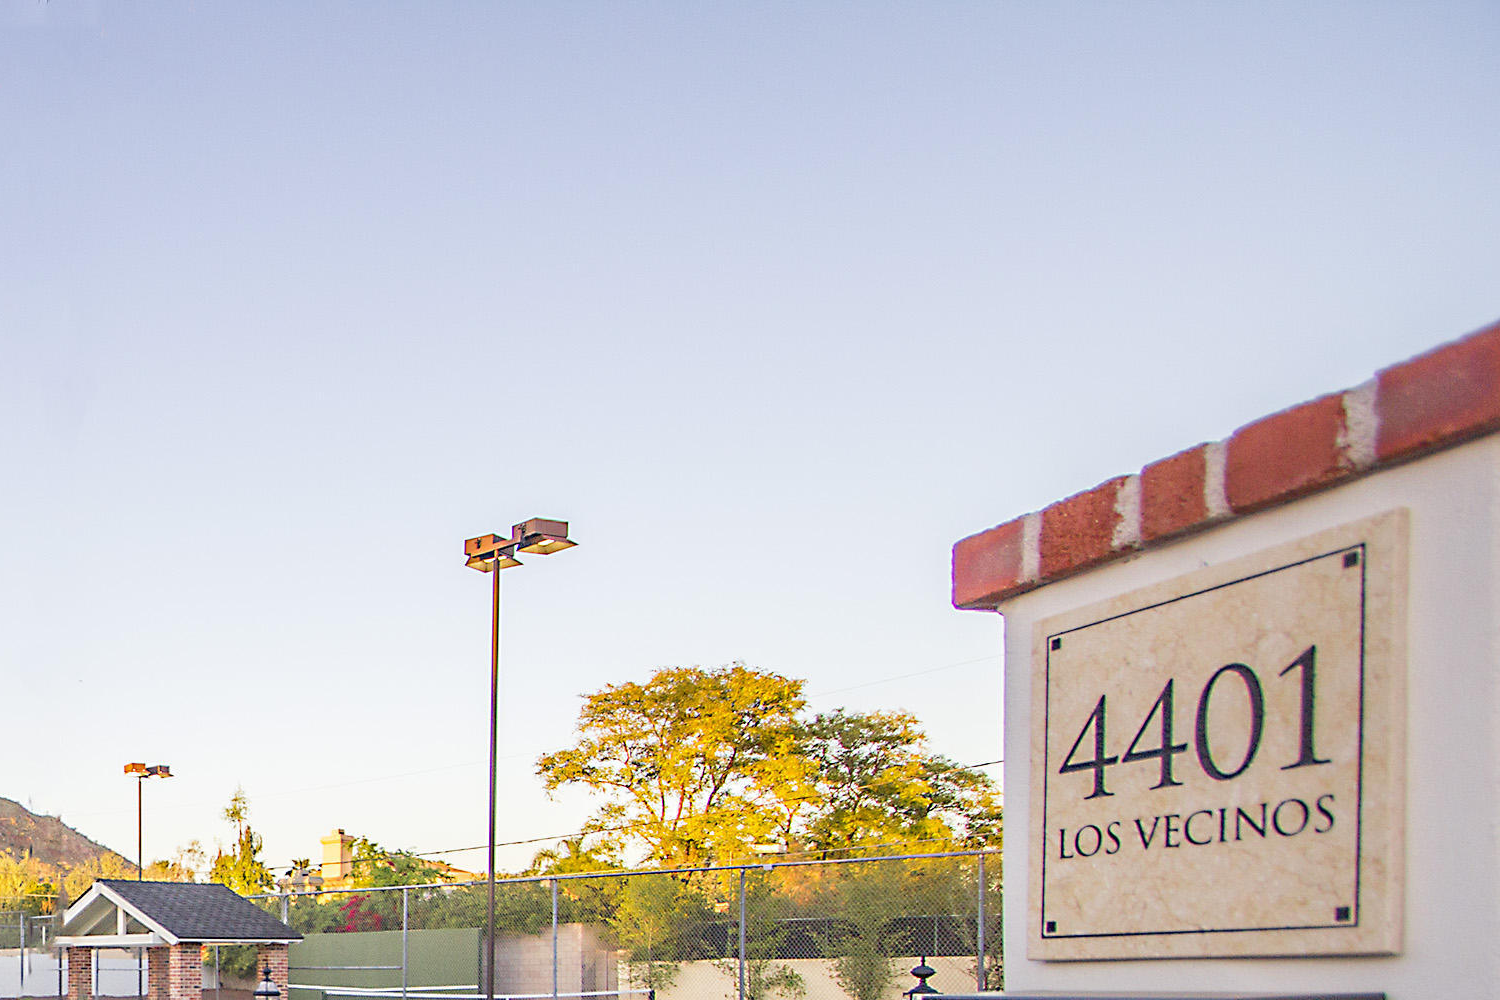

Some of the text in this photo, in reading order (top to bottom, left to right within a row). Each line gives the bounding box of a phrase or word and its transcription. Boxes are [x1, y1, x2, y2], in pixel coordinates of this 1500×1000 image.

[1058, 645, 1332, 800] 4401
[1058, 794, 1336, 860] LOS VECINOS
